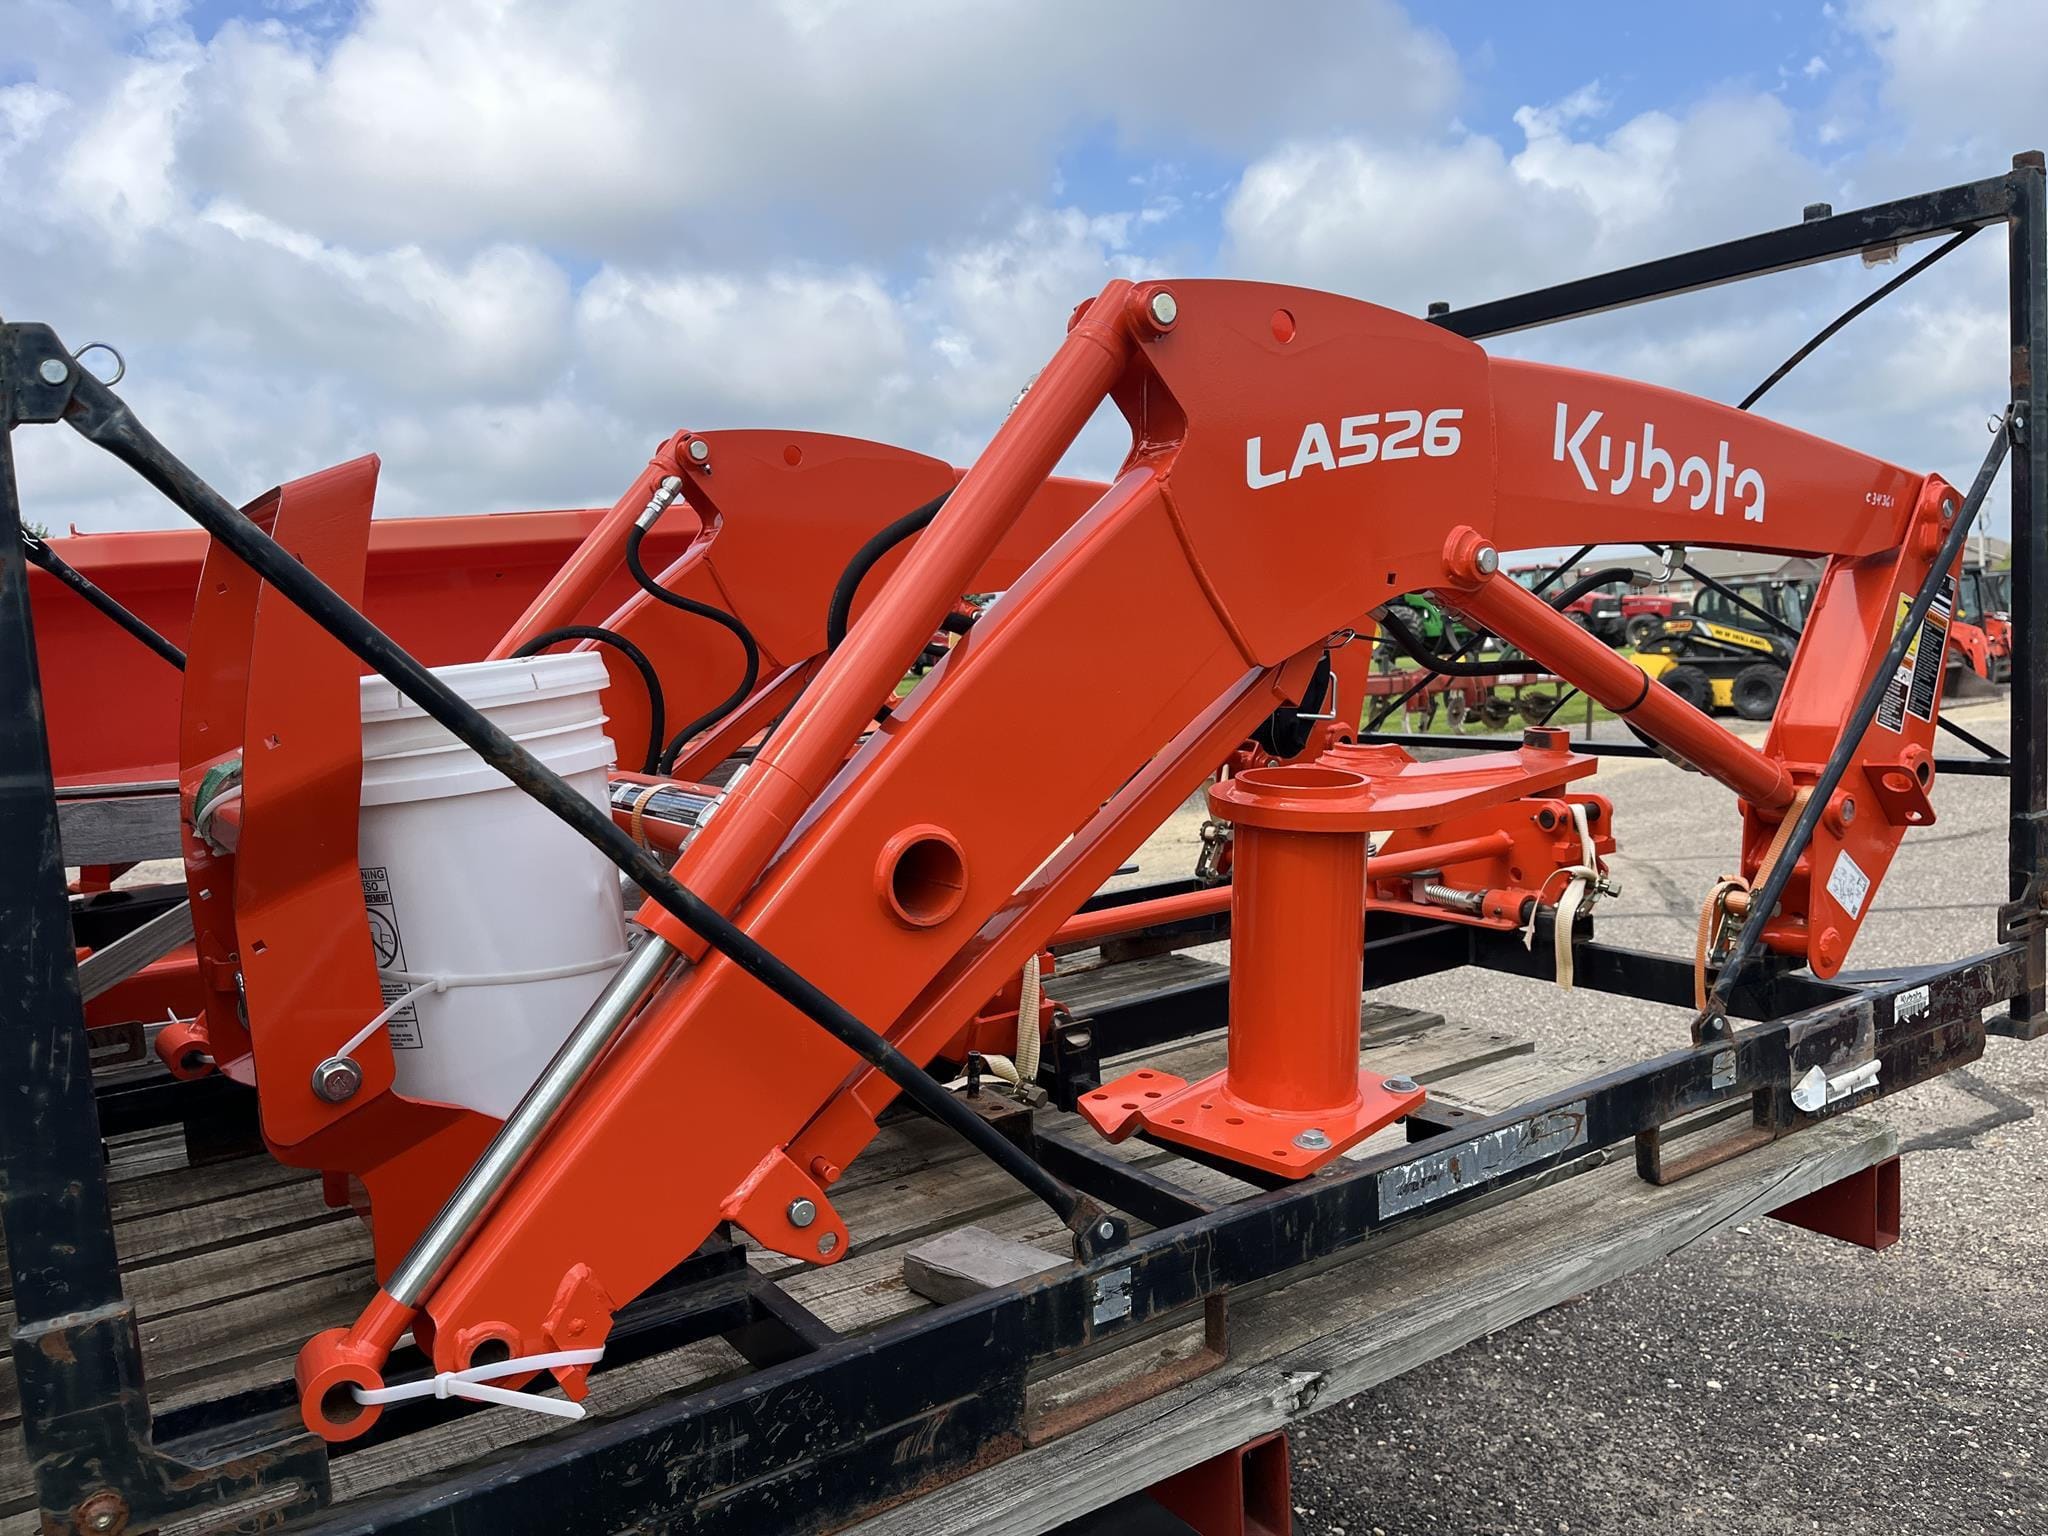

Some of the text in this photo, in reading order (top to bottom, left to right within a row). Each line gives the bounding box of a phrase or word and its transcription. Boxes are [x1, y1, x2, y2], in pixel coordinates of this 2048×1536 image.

[1246, 408, 1464, 489] LA526
[1553, 402, 1765, 522] Kubota
[361, 870, 384, 880] NING
[363, 882, 378, 892] ISO
